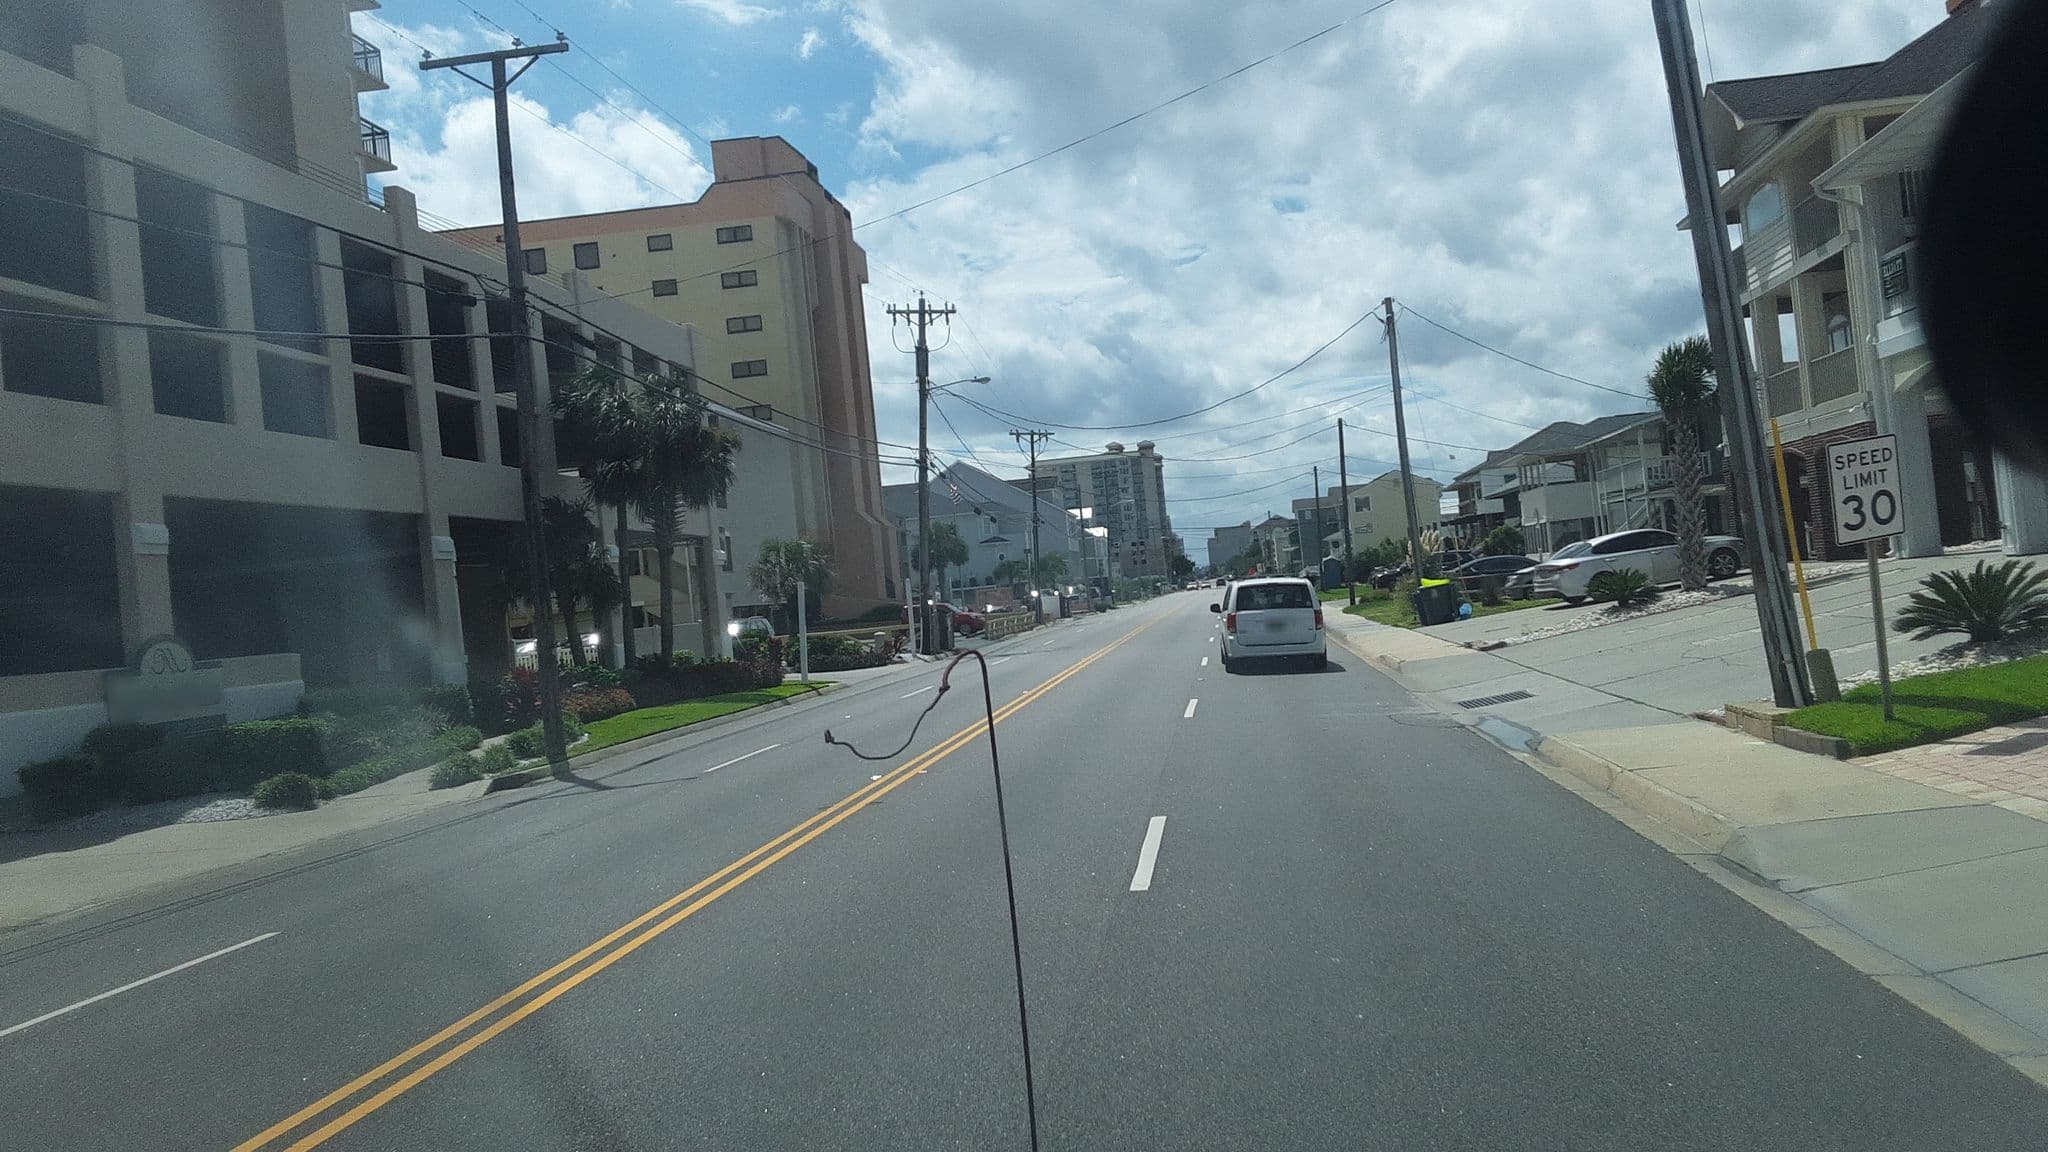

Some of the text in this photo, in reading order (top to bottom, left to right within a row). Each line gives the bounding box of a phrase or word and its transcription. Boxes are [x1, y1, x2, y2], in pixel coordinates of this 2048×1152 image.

[1835, 447, 1893, 470] SPEED
[1843, 468, 1887, 490] LIMIT
[1842, 489, 1897, 531] 30
